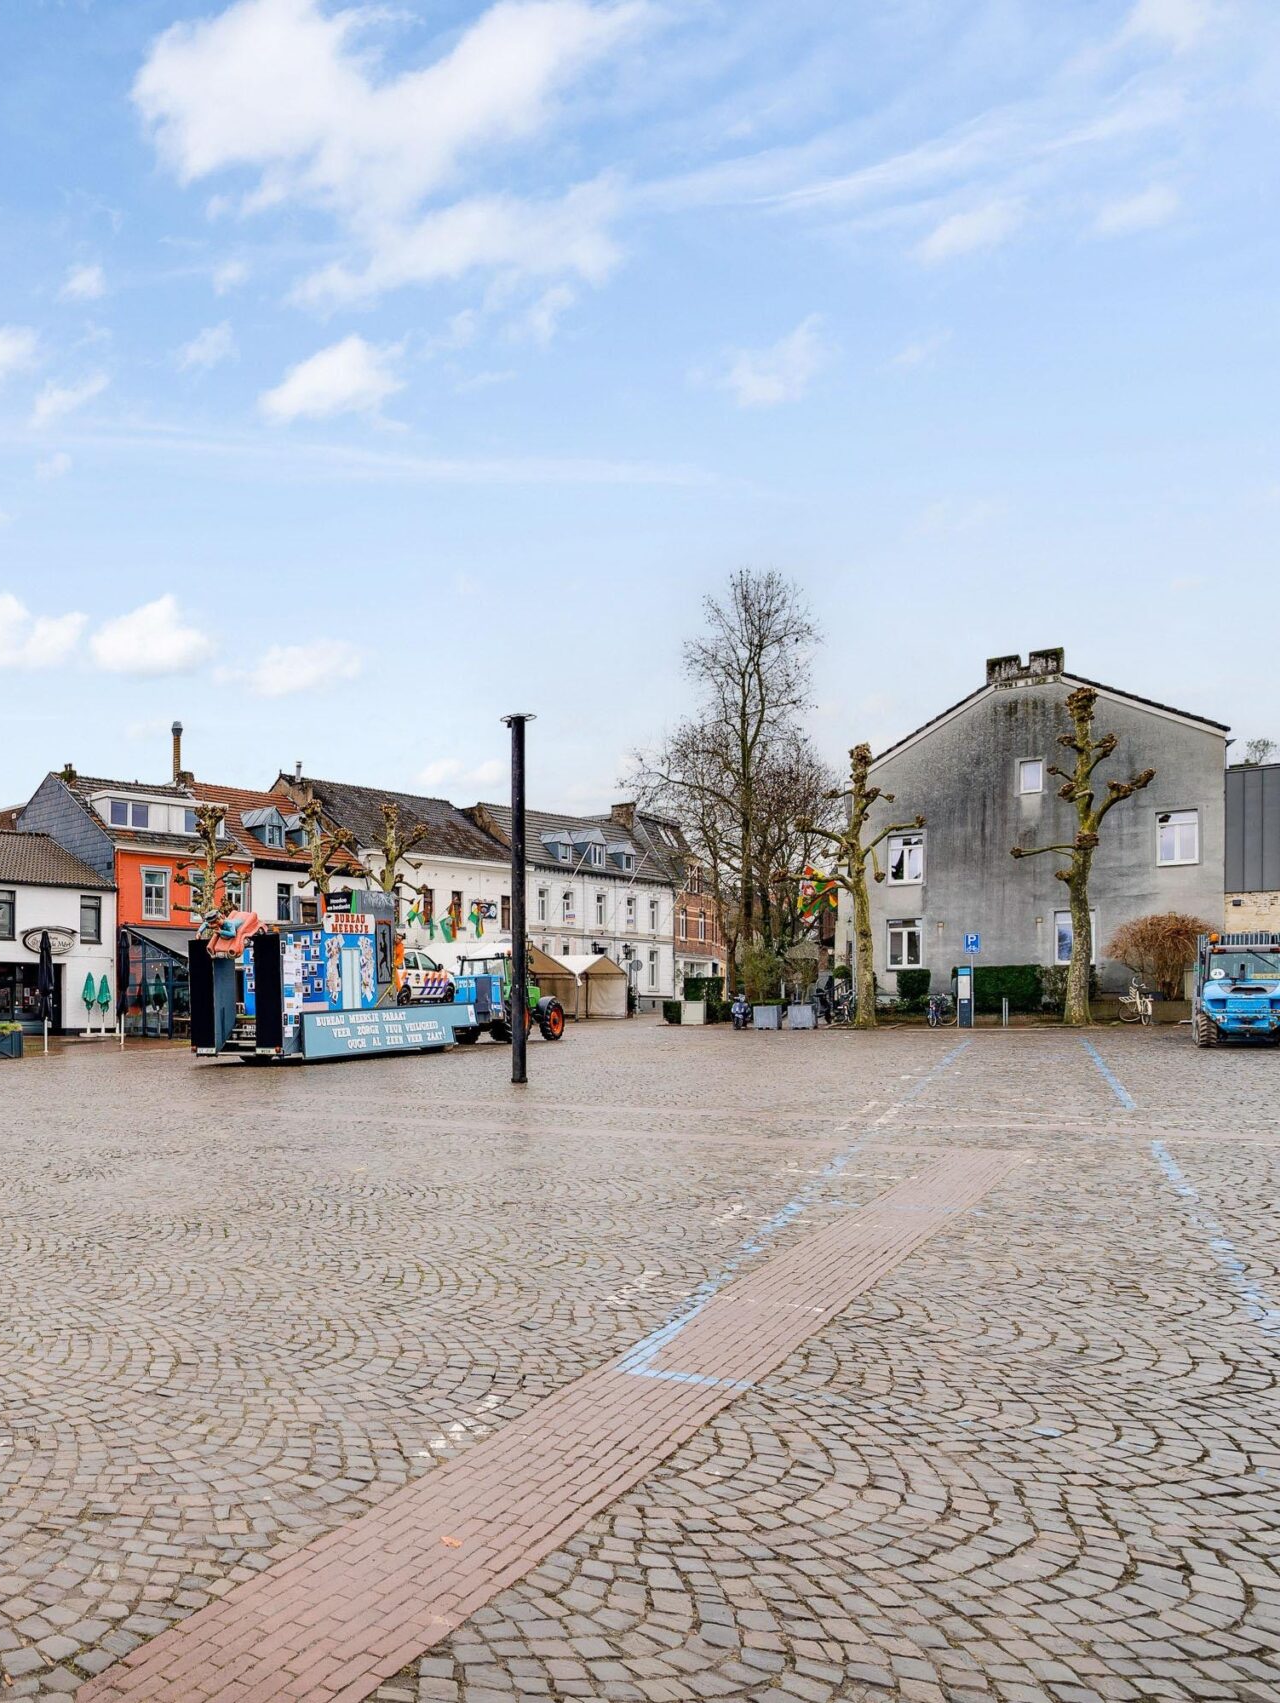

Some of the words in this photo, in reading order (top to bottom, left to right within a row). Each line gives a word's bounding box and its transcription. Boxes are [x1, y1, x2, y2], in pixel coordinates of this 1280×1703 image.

[334, 914, 365, 923] BUREAU
[331, 924, 369, 933] MEERSJE
[967, 935, 976, 945] P
[316, 1015, 344, 1027] BUREAU
[348, 1013, 379, 1024] MEERSJE
[382, 1011, 406, 1021] PARAAT
[372, 1036, 381, 1046] AL
